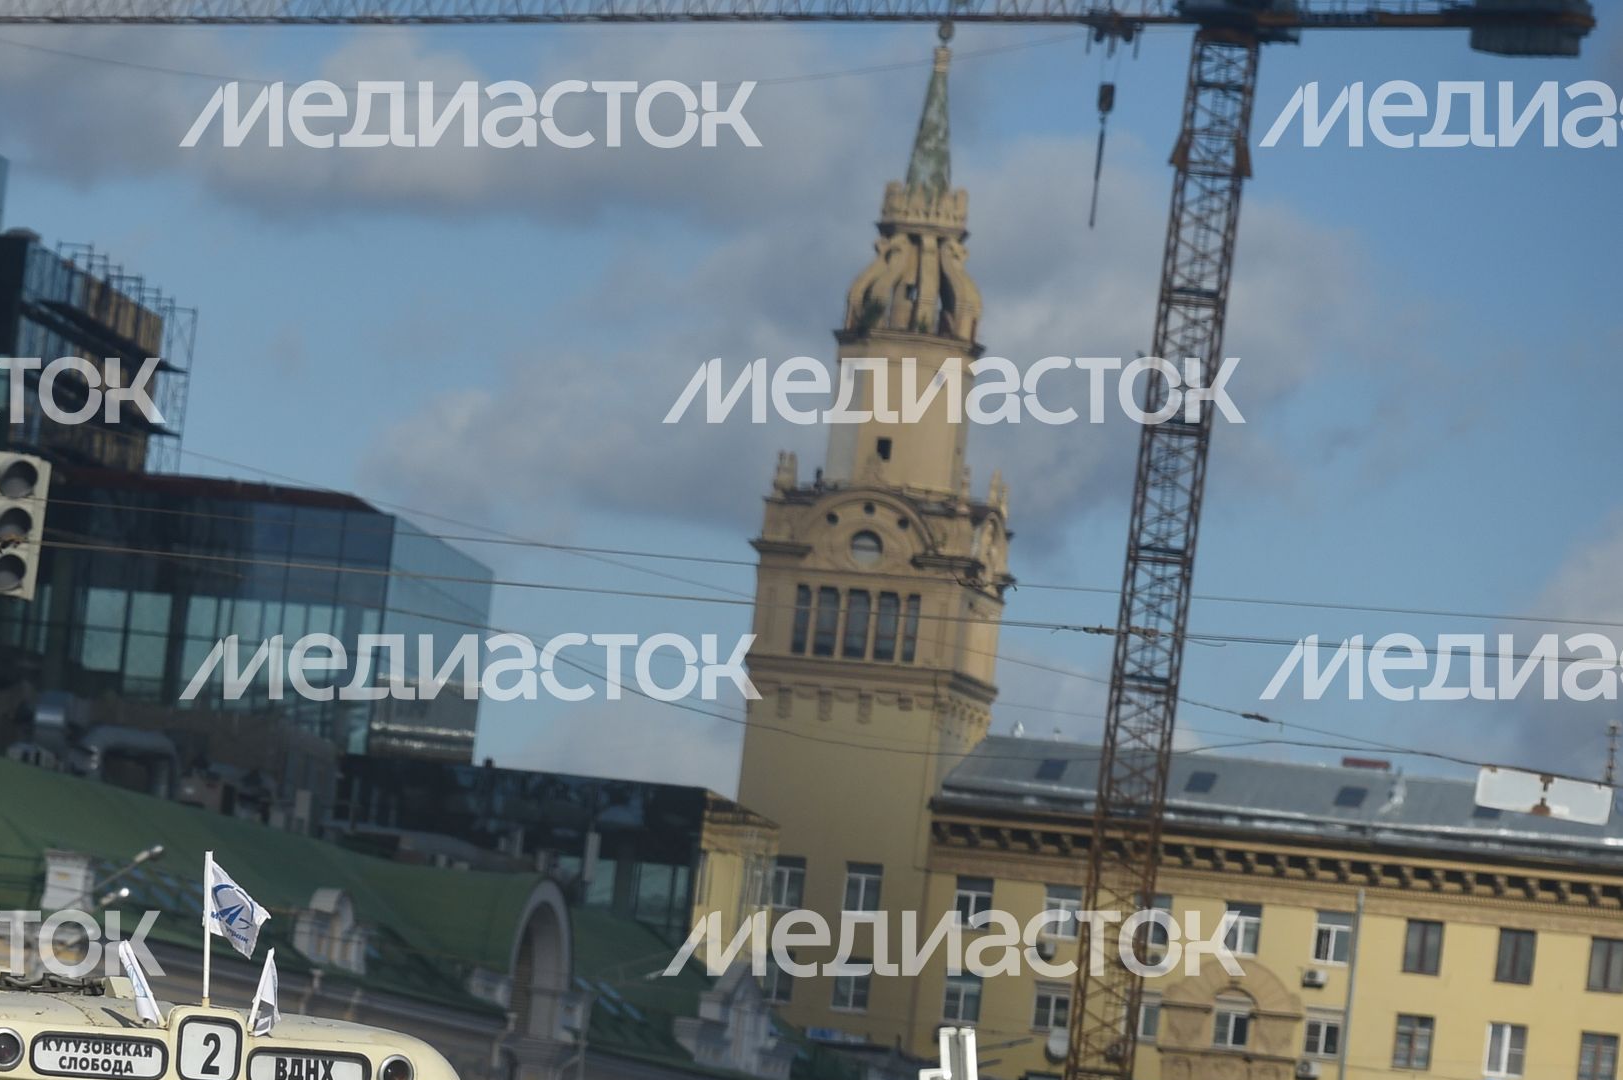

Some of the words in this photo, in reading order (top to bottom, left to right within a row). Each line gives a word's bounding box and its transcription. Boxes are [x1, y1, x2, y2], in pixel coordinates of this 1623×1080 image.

[42, 1038, 154, 1059] КУТУЗОВСКАЯ
[200, 1032, 221, 1075] 2
[58, 1055, 134, 1075] СЛОБОДА
